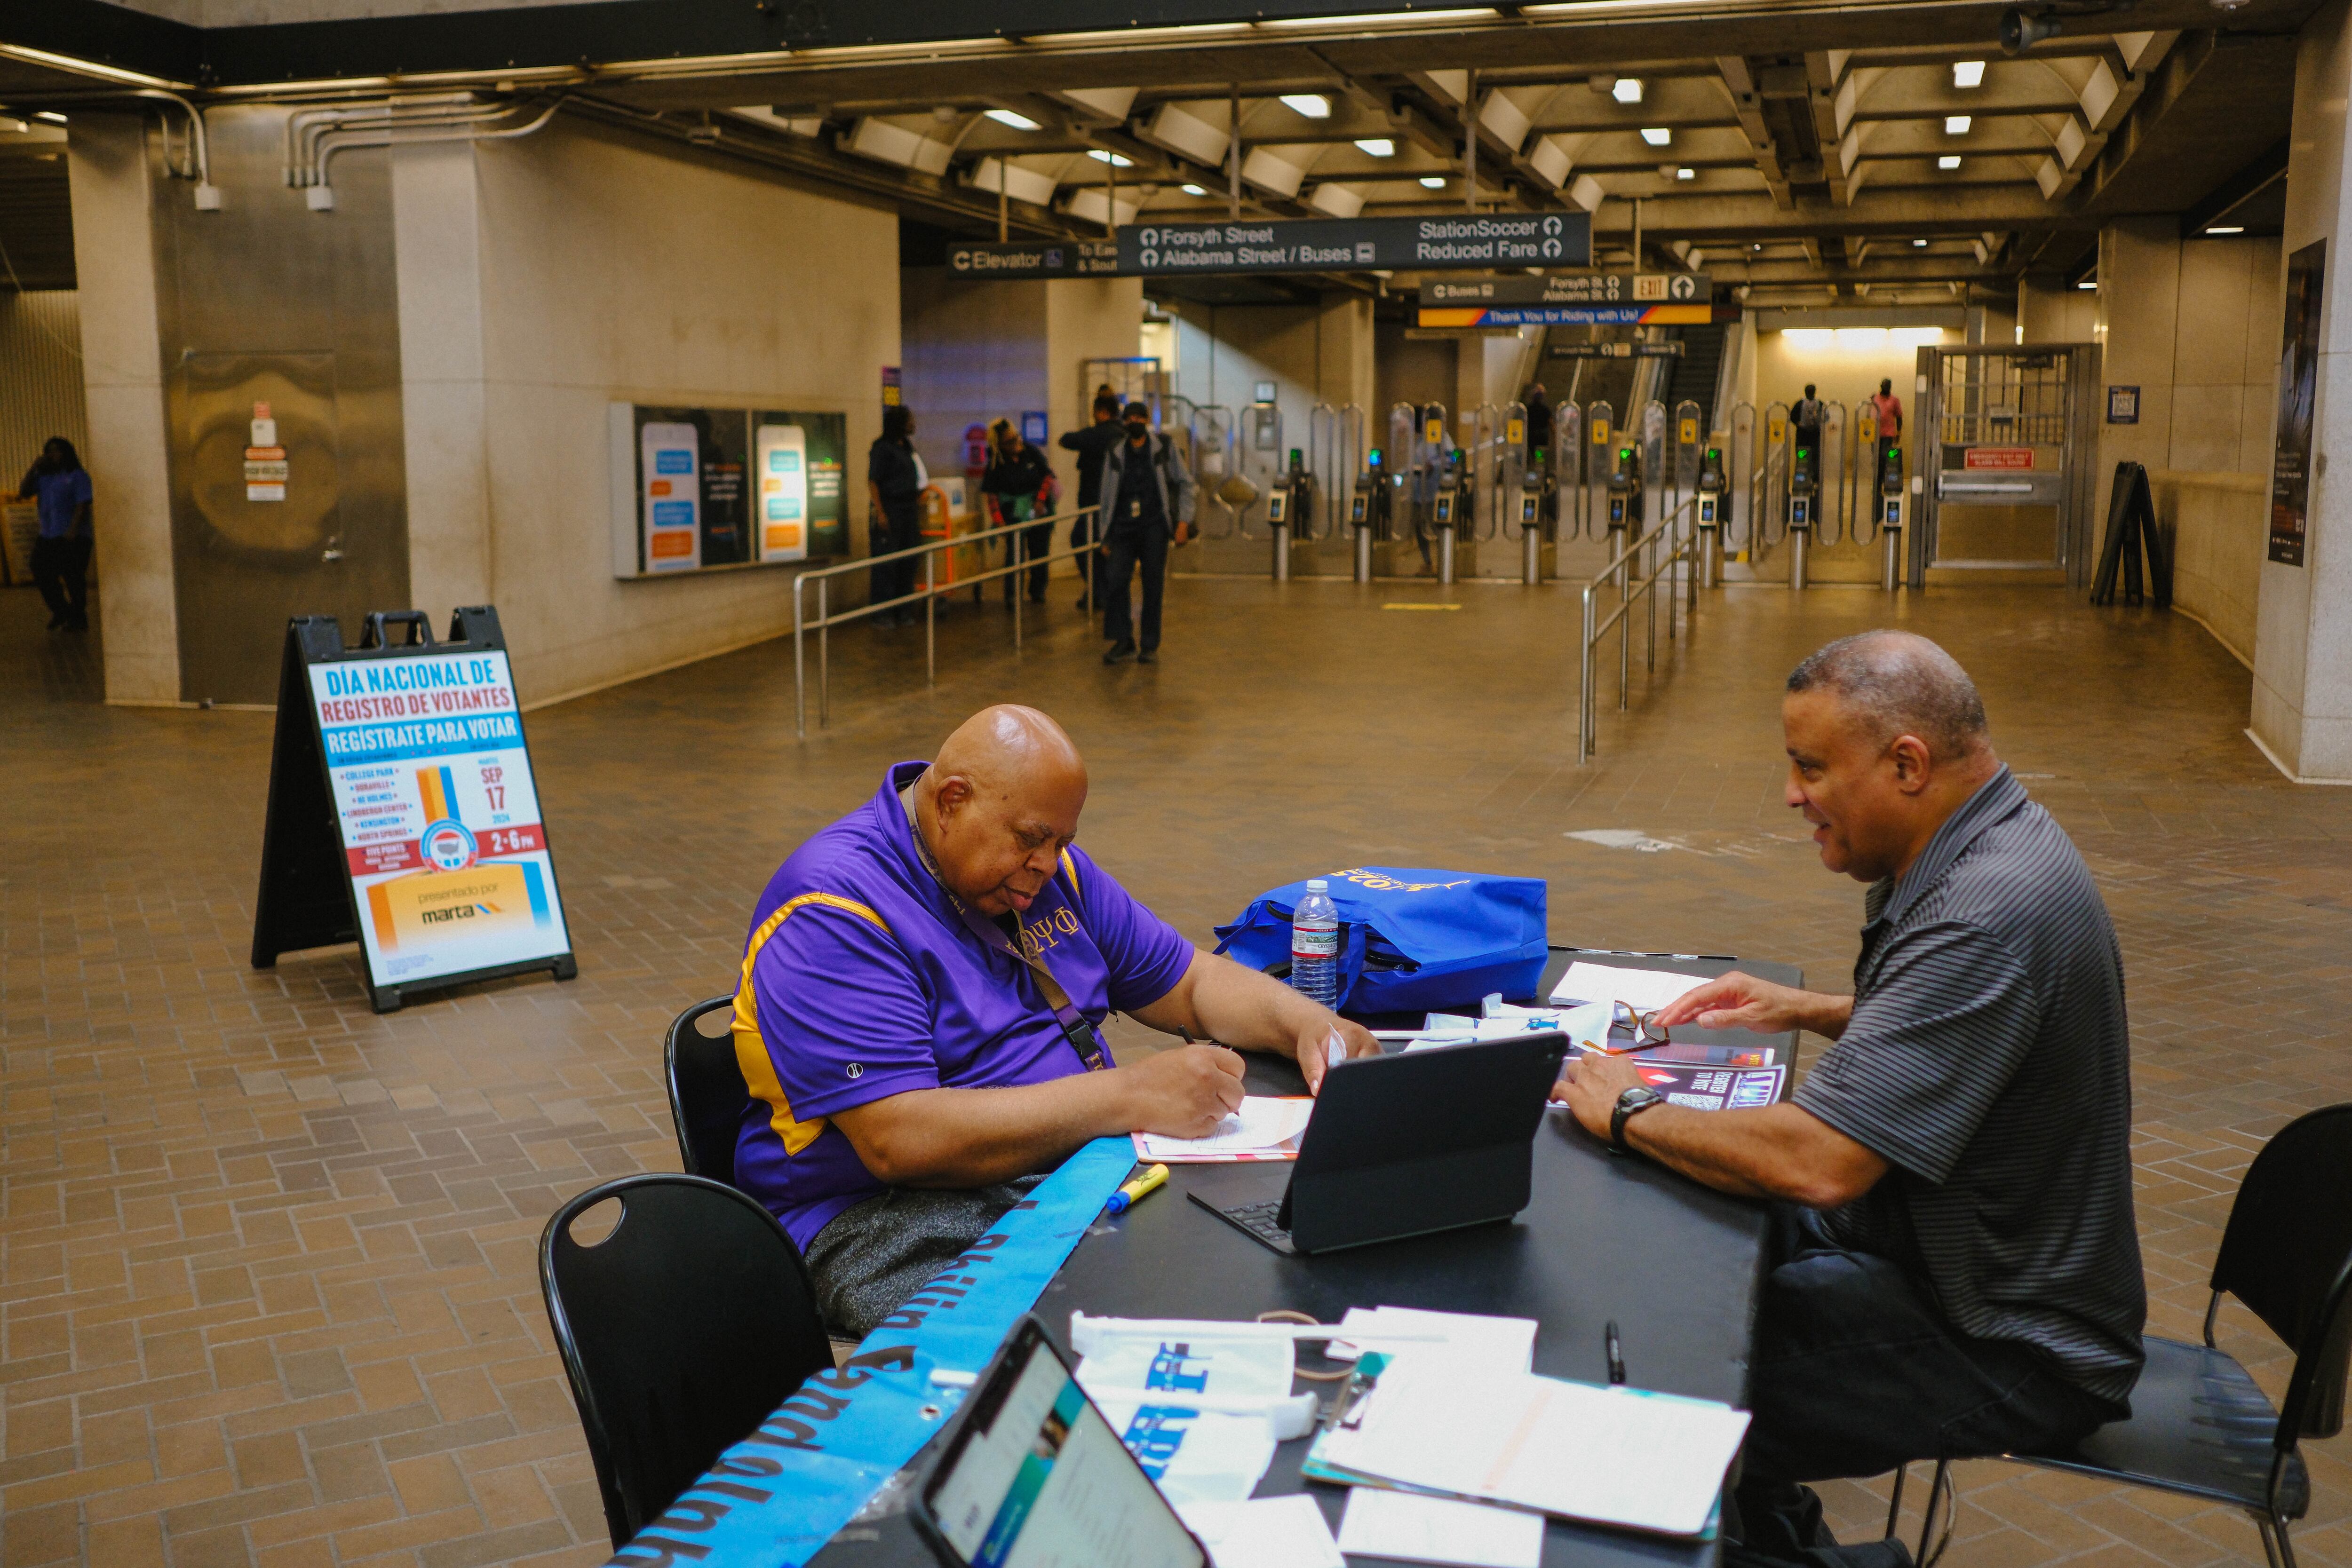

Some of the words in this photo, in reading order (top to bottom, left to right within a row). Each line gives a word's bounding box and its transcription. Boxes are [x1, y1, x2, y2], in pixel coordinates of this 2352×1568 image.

[1161, 228, 1222, 248] Forsyth
[1224, 226, 1274, 244] Street
[1420, 219, 1538, 239] StationSoccer
[971, 250, 1042, 270] Elevator
[1161, 249, 1234, 267] Alabama
[1238, 246, 1287, 264] Street
[1289, 245, 1297, 263] /
[1299, 245, 1352, 263] Buses
[1417, 240, 1493, 260] Reduced
[1498, 240, 1538, 258] Fare
[1446, 284, 1480, 298] Buses
[1549, 276, 1589, 291] Forsyth
[1639, 279, 1662, 296] EXIT
[1542, 289, 1589, 301] Alabama
[1490, 309, 1522, 323] Thank
[1522, 310, 1543, 323] You
[1545, 309, 1559, 322] for
[1561, 309, 1595, 324] Riding
[1597, 309, 1619, 321] with
[1620, 309, 1639, 321] Us!
[326, 665, 365, 696] DÍA
[366, 662, 469, 693] NACIONAL
[469, 659, 496, 684] DE
[320, 695, 405, 723] REGISTRO
[407, 693, 429, 715] DE
[430, 687, 511, 713] VOTANTES
[327, 724, 425, 754] REGÍSTRATE
[426, 720, 469, 749] PARA
[467, 716, 517, 740] VOTAR
[481, 766, 503, 784] SEP
[485, 785, 505, 810] 17
[492, 814, 510, 824] 2024
[418, 885, 478, 905] presentado
[480, 883, 499, 895] por
[422, 904, 475, 925] marta
[1748, 1054, 1761, 1066] VOTE
[1691, 1078, 1713, 1091] VOTE
[1708, 1071, 1734, 1094] REGISTER
